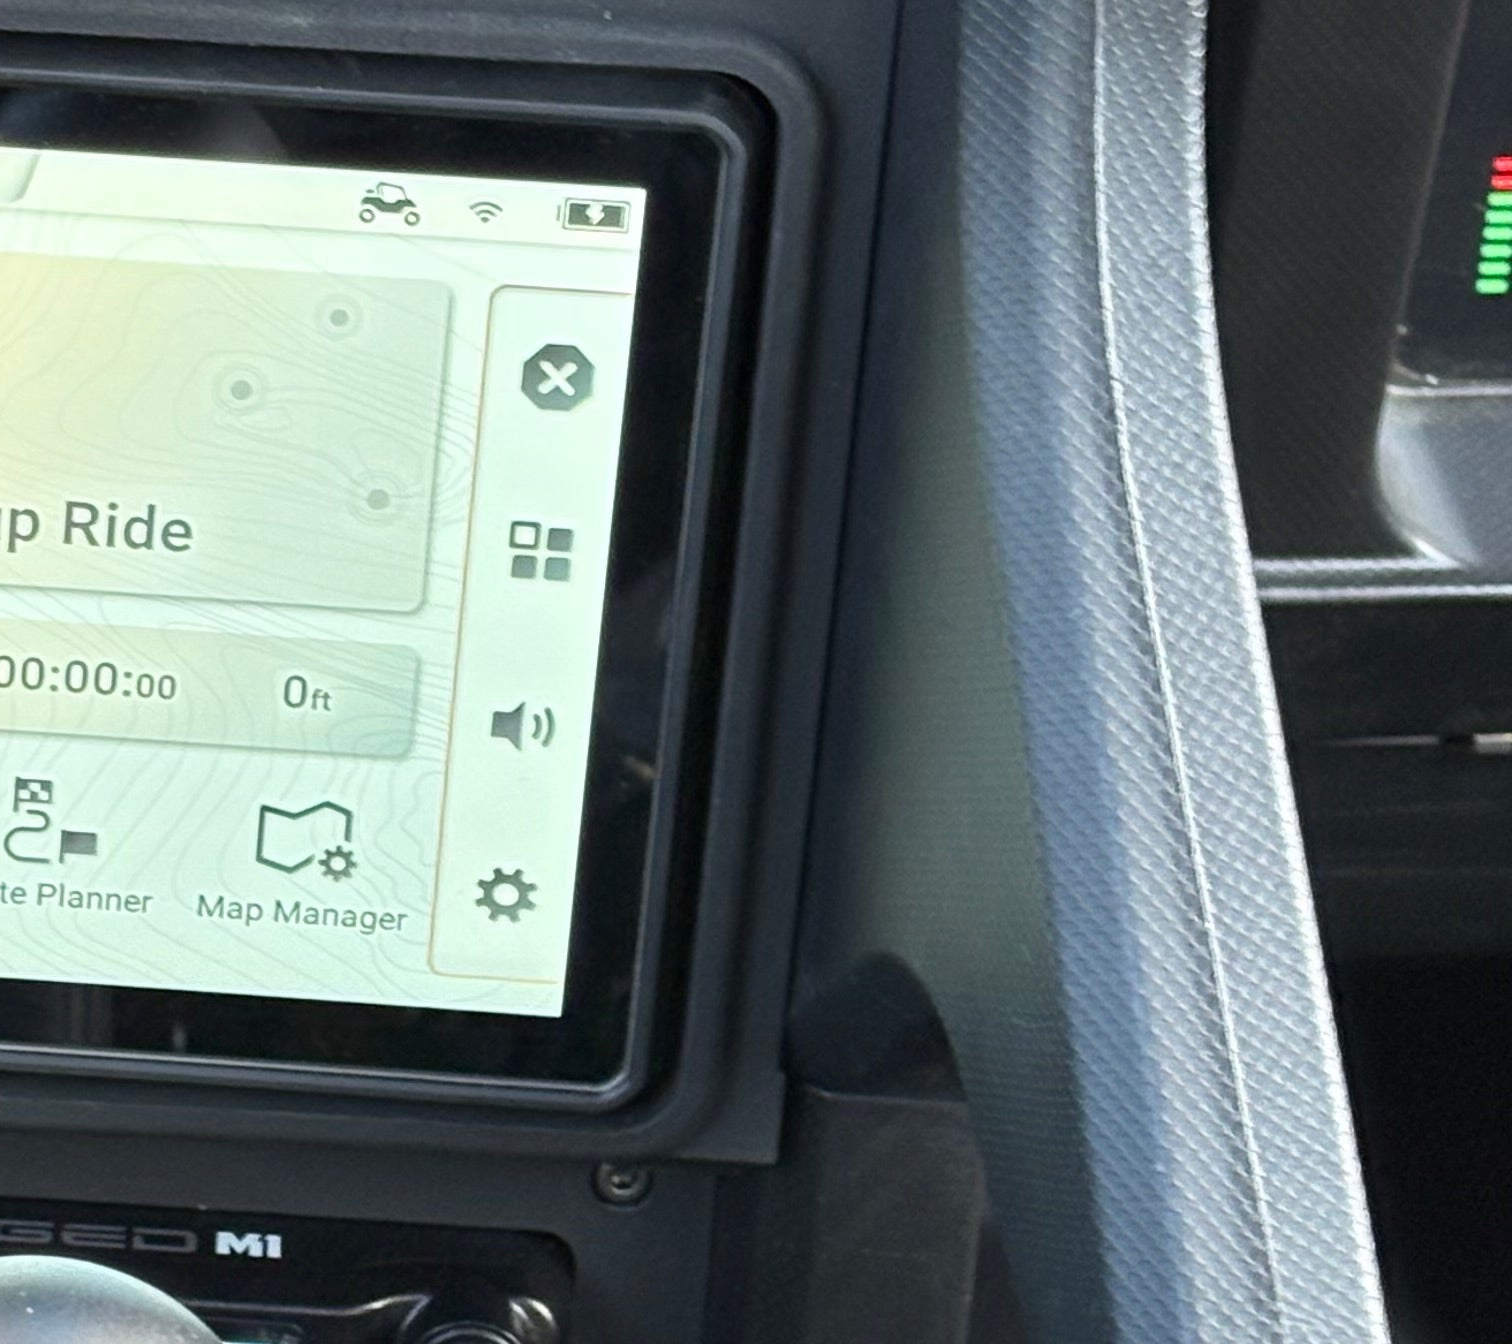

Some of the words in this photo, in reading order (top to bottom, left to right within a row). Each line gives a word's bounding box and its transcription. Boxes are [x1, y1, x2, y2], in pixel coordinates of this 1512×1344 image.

[63, 499, 195, 552] Ride
[36, 883, 153, 915] Planner
[196, 895, 263, 926] Map
[274, 900, 408, 935] Manager
[215, 1231, 283, 1258] M1
